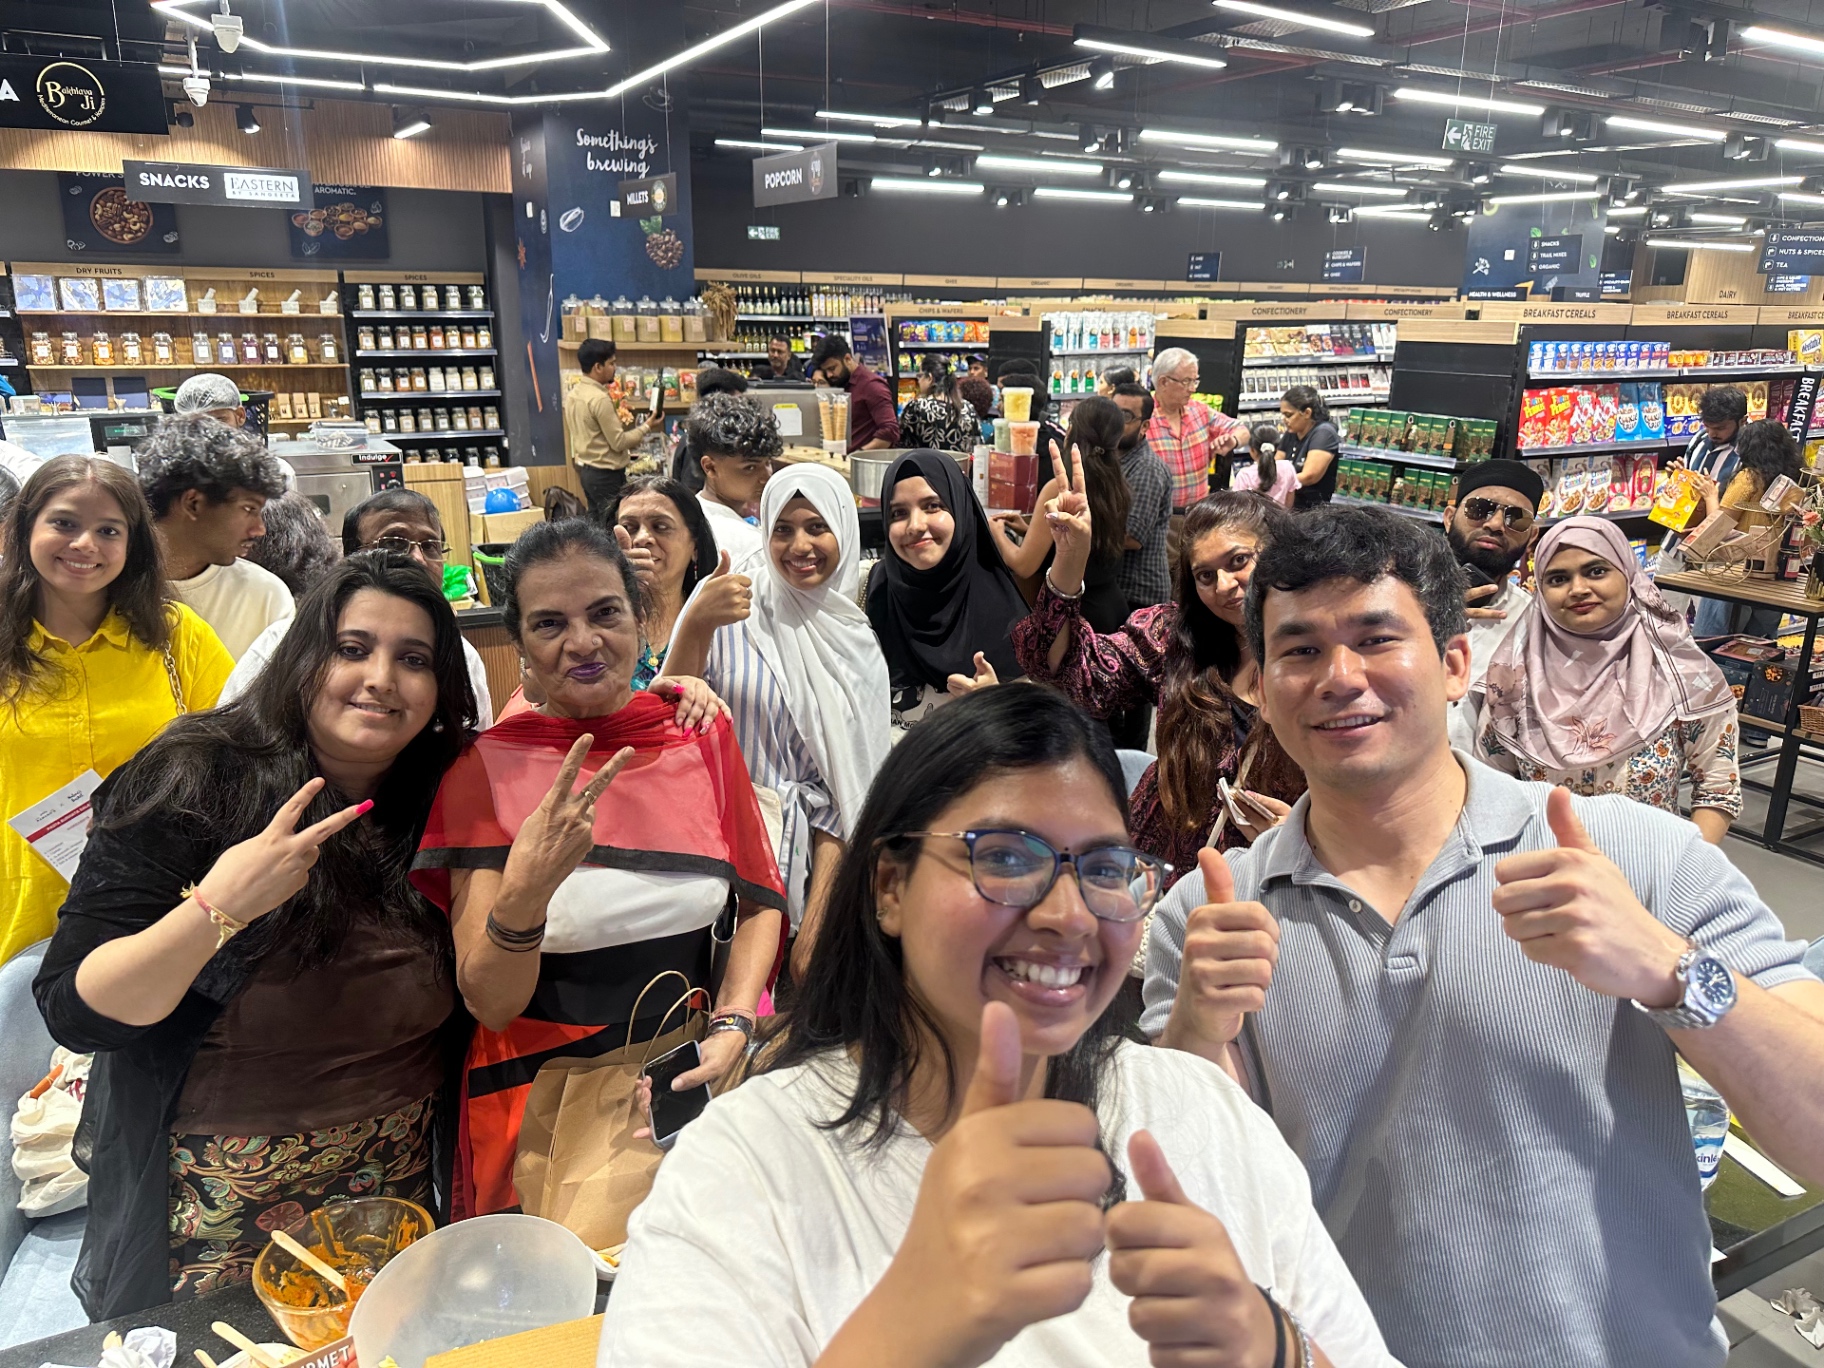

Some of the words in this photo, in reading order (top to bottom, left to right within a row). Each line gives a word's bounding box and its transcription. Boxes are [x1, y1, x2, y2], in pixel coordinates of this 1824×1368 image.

[0, 78, 20, 101] A
[80, 95, 96, 110] Ji
[1474, 125, 1495, 139] FIRE
[576, 128, 658, 159] Something's
[1472, 137, 1493, 151] EXIT
[586, 151, 651, 179] brewing
[139, 172, 210, 189] SNACKS
[230, 177, 294, 192] EASTERN
[765, 168, 802, 189] POPCORN
[626, 191, 649, 205] MILLETS
[1719, 290, 1737, 299] DAIRY
[1251, 307, 1307, 315] CONFECTIONERY
[1384, 308, 1433, 316] CONFECTIONERY
[1523, 308, 1564, 318] BREAKFAST
[1565, 309, 1596, 318] CEREALS
[1666, 311, 1701, 319] BREAKFAST
[1702, 310, 1728, 319] CEREALS
[1789, 376, 1815, 443] BREAKFAST
